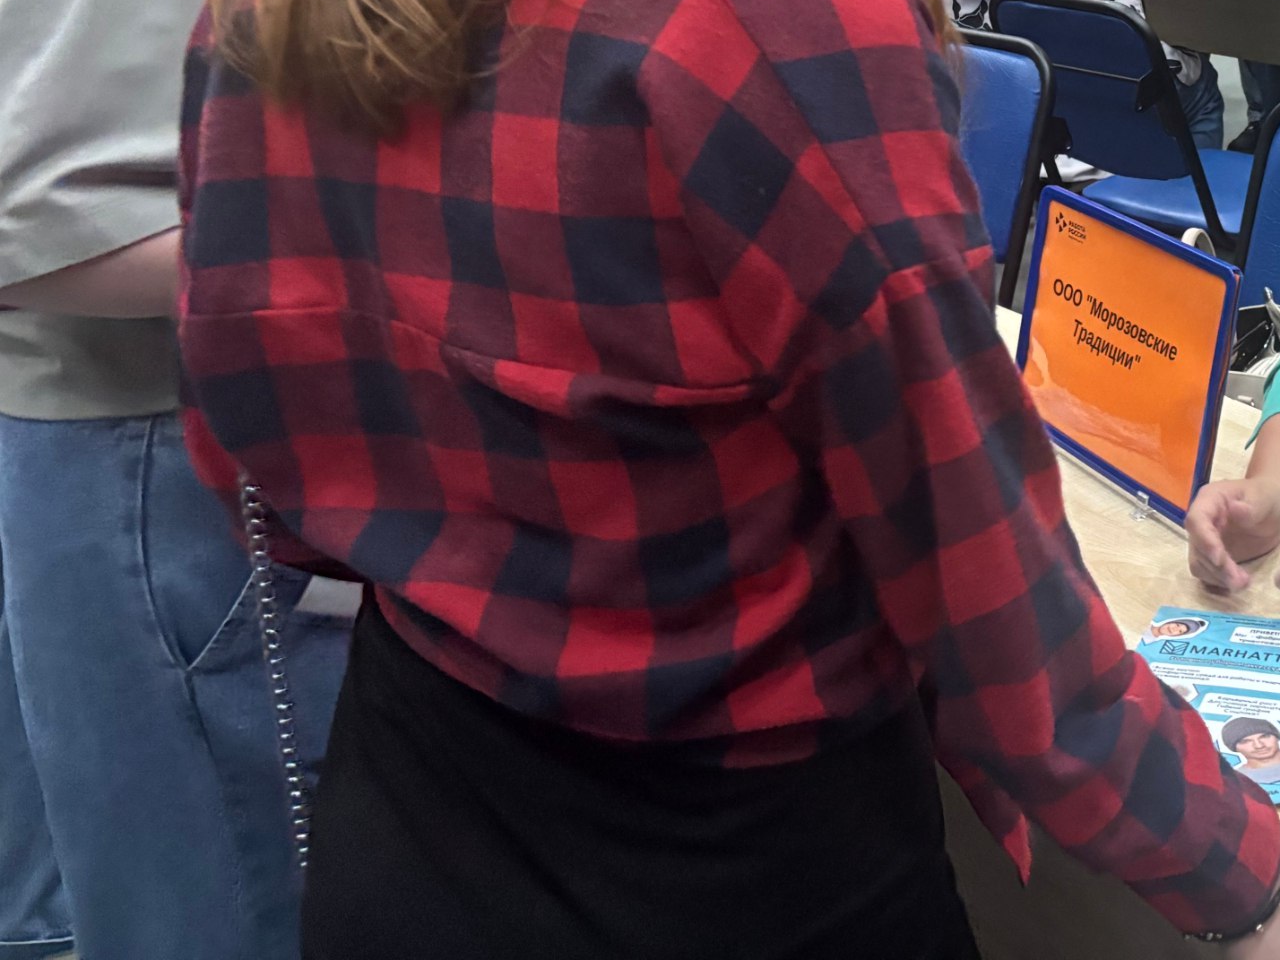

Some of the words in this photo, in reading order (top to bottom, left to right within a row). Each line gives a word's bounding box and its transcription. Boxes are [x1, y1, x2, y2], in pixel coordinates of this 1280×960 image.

[1053, 278, 1083, 307] ООО
[1087, 294, 1178, 361] "Морозовские
[1073, 319, 1141, 370] Традиции"
